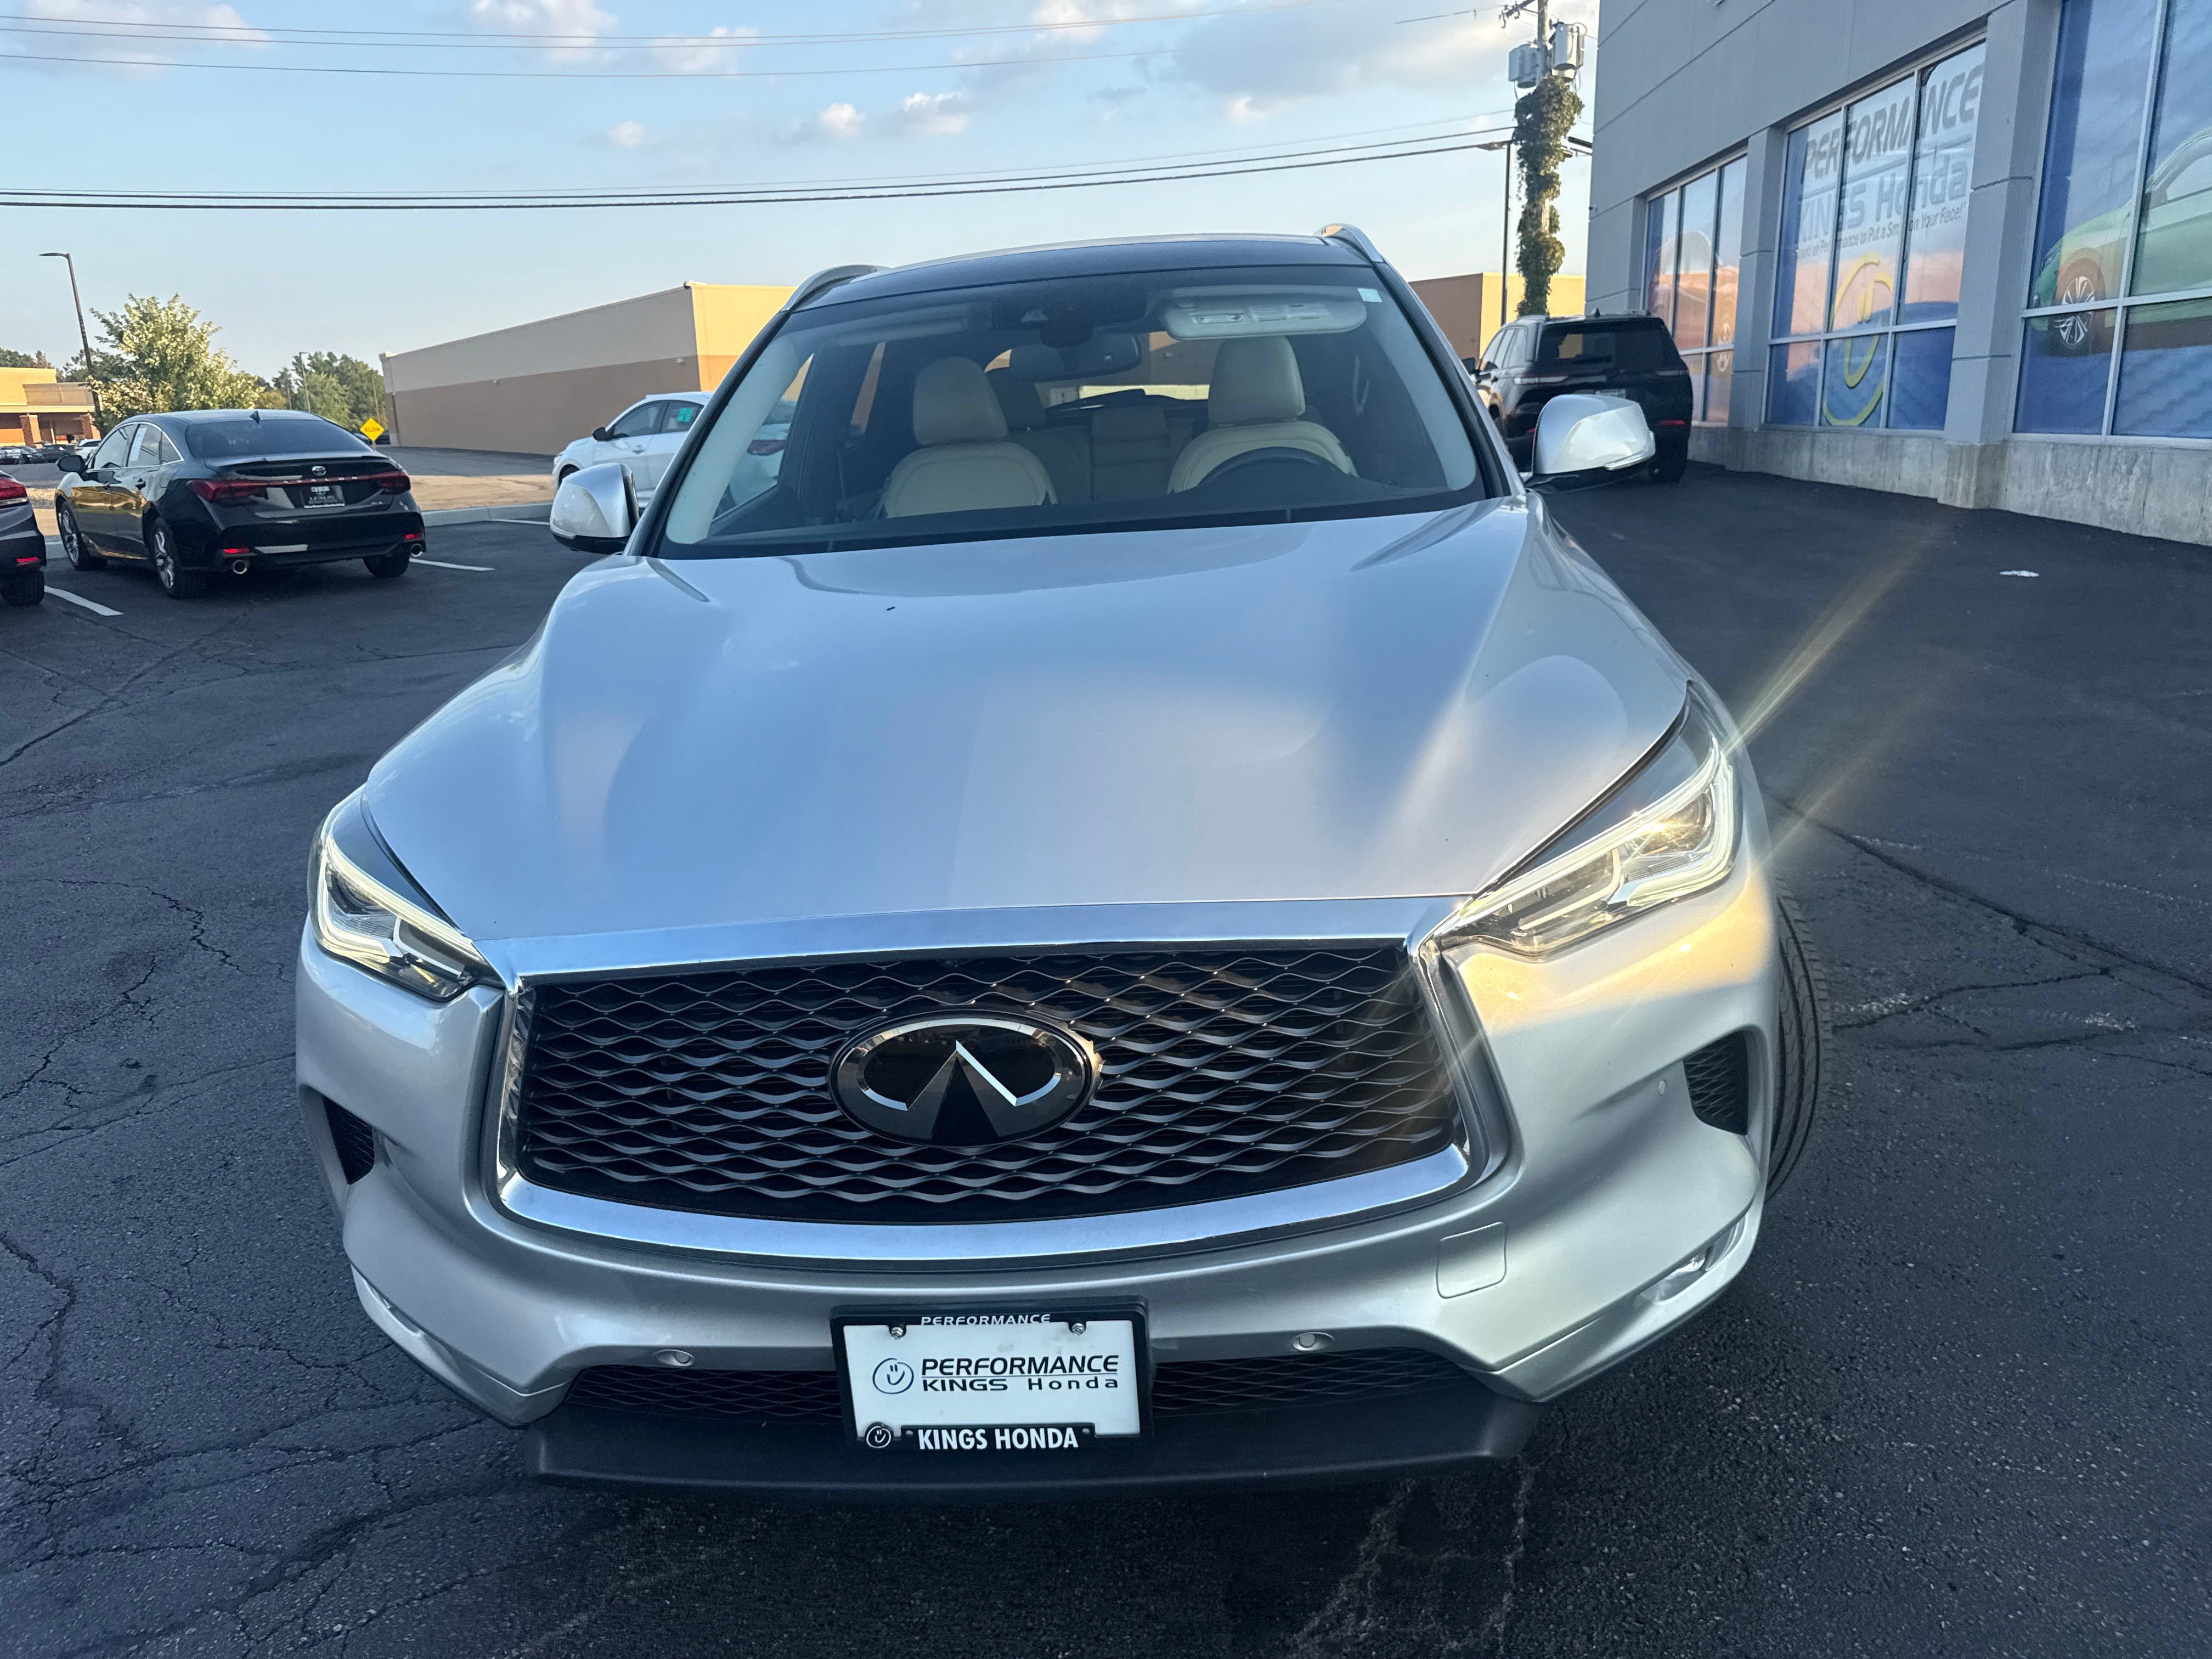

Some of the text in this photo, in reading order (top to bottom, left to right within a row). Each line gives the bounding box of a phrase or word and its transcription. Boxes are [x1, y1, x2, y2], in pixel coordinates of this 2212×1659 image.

[1801, 63, 1984, 181] PERFORMNCE
[1796, 154, 1968, 242] KINS Honda
[1921, 212, 1939, 229] Your
[921, 1314, 1051, 1325] PERFORMANCE
[922, 1355, 1119, 1375] PERFORMANCE
[923, 1376, 1119, 1391] KINGS Honda
[918, 1427, 1079, 1450] KINGS HONDA
